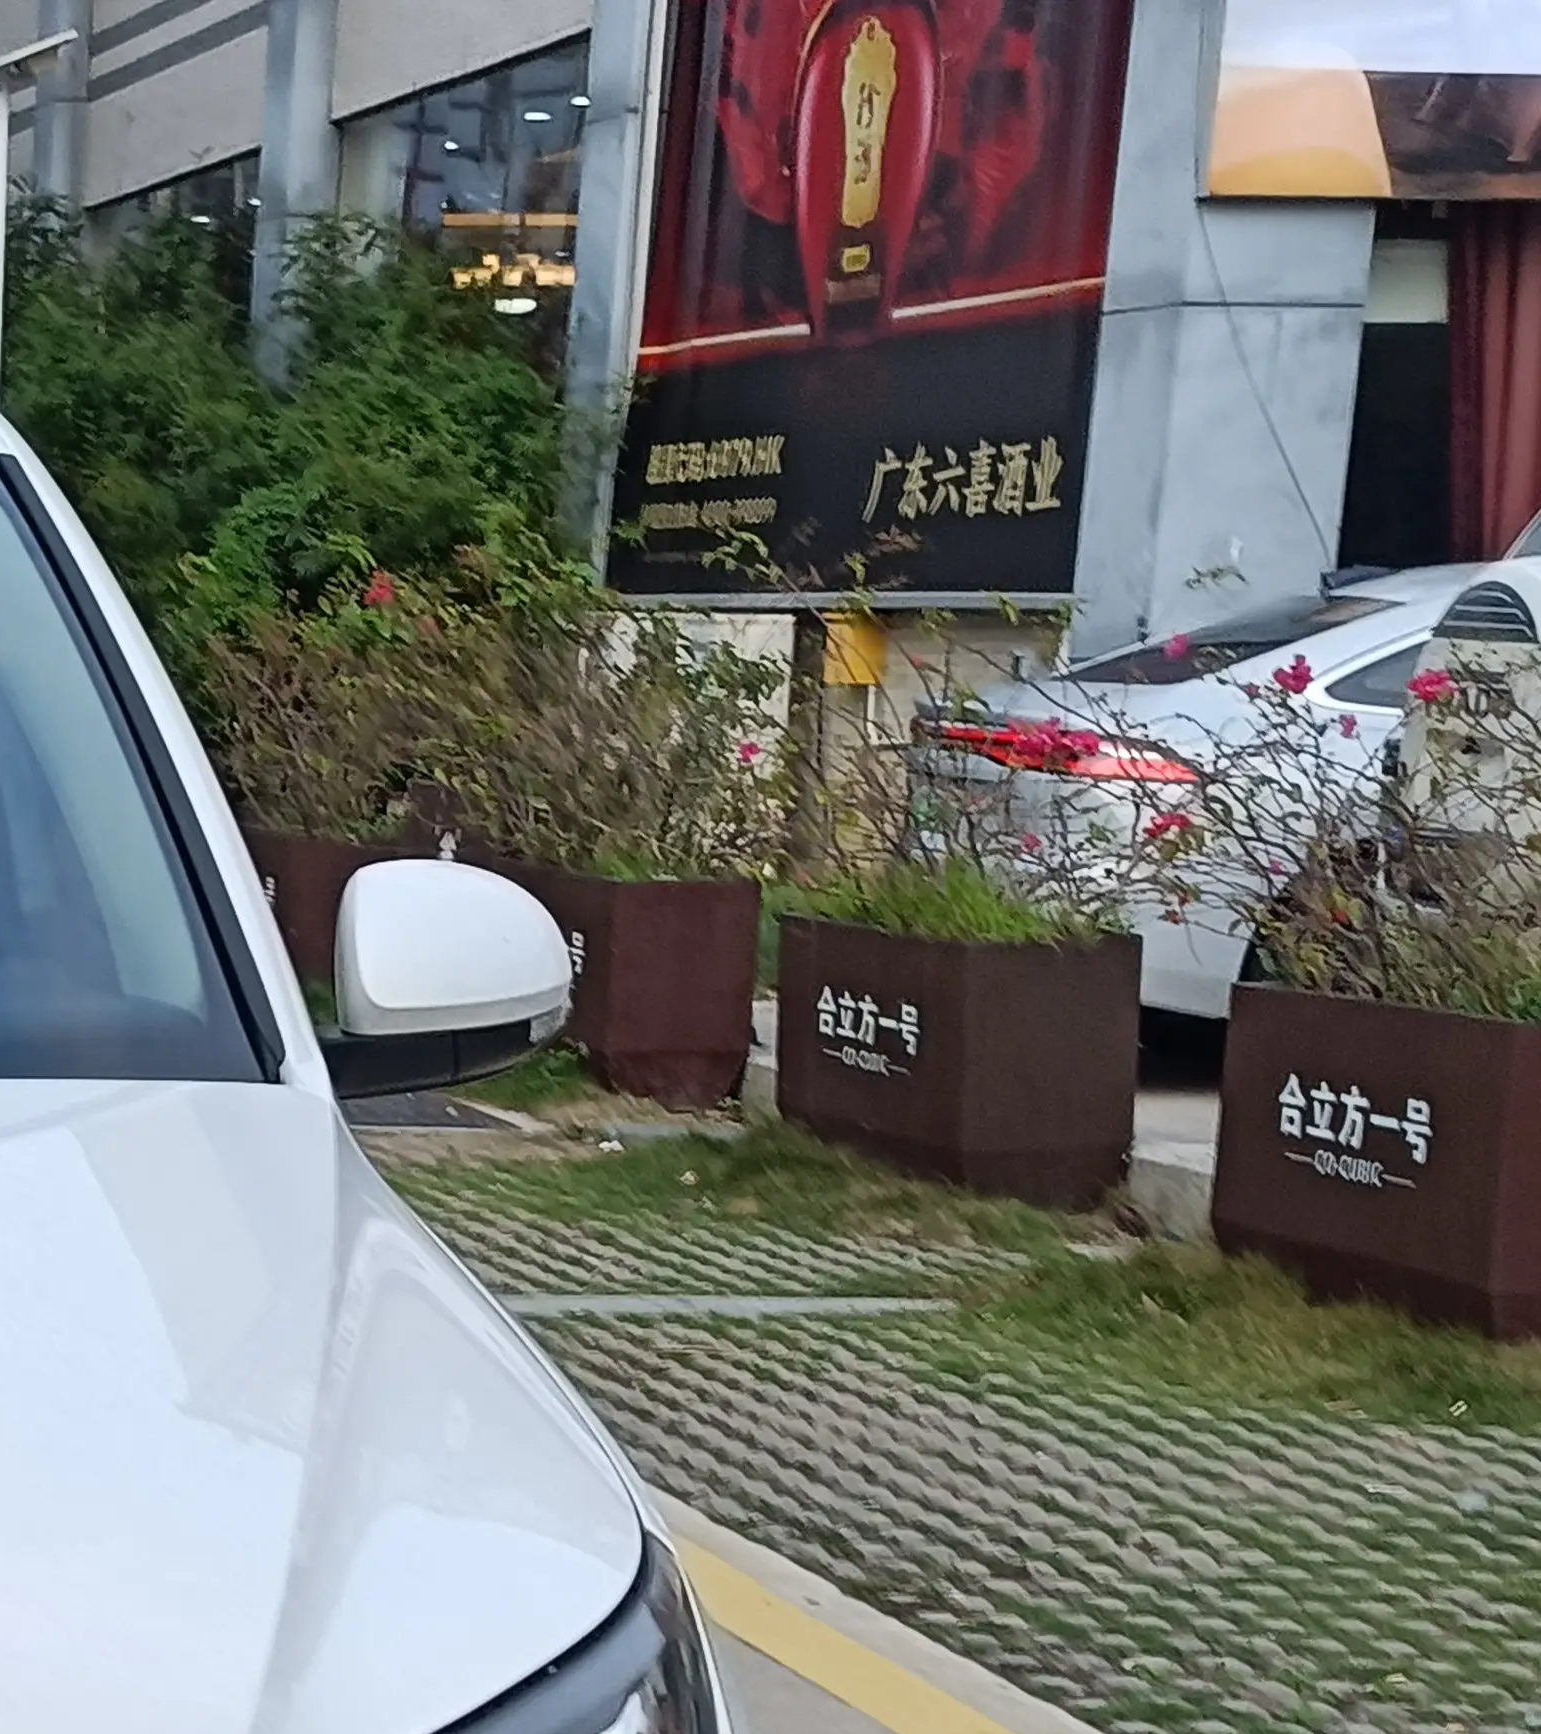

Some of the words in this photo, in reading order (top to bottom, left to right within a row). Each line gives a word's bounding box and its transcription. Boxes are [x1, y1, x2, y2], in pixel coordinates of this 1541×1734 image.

[862, 435, 1064, 523] 广东六喜酒业
[817, 985, 920, 1056] 合立方一号
[1278, 1072, 1433, 1165] 合立方一号
